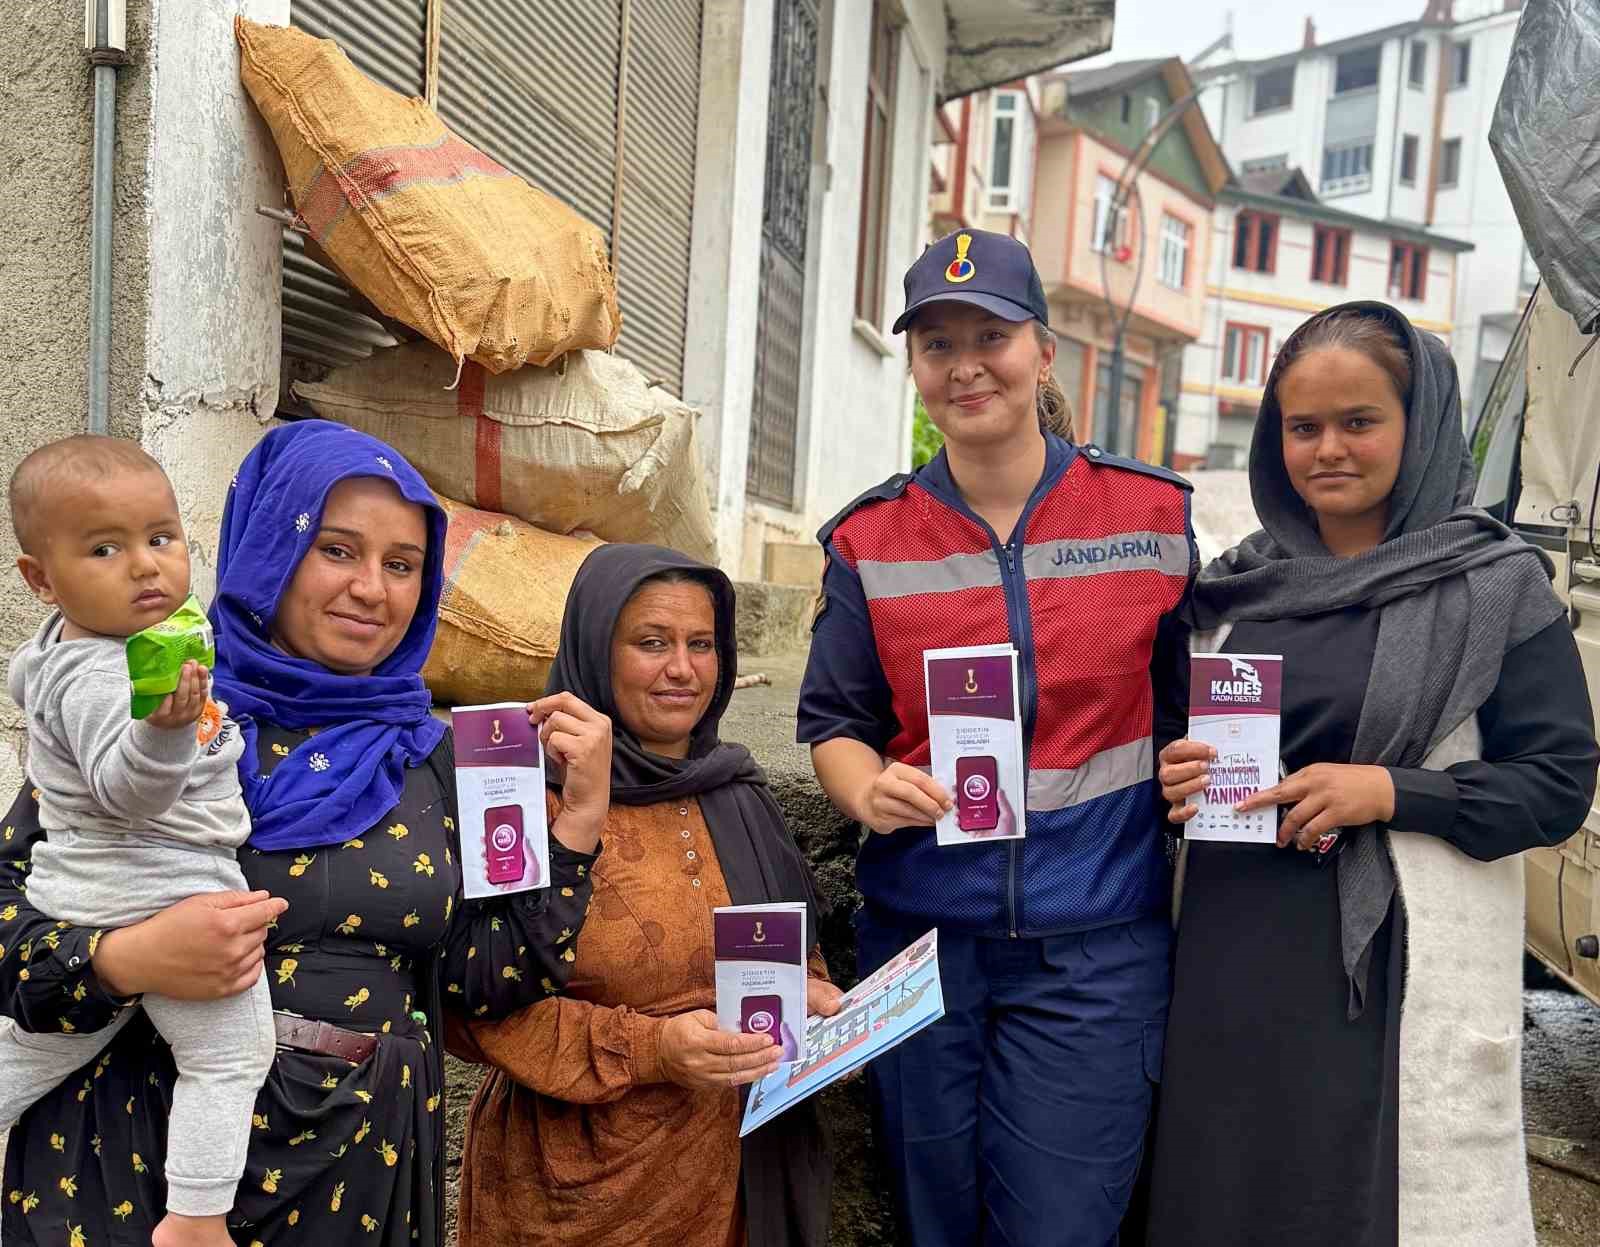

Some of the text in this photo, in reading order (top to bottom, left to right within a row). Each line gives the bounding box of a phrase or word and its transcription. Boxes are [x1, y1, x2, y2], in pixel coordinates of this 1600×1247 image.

[1051, 540, 1162, 566] JANDARMA
[1211, 680, 1262, 696] KADES
[1234, 695, 1262, 703] DESTEK
[1209, 773, 1260, 786] ADINLARIN
